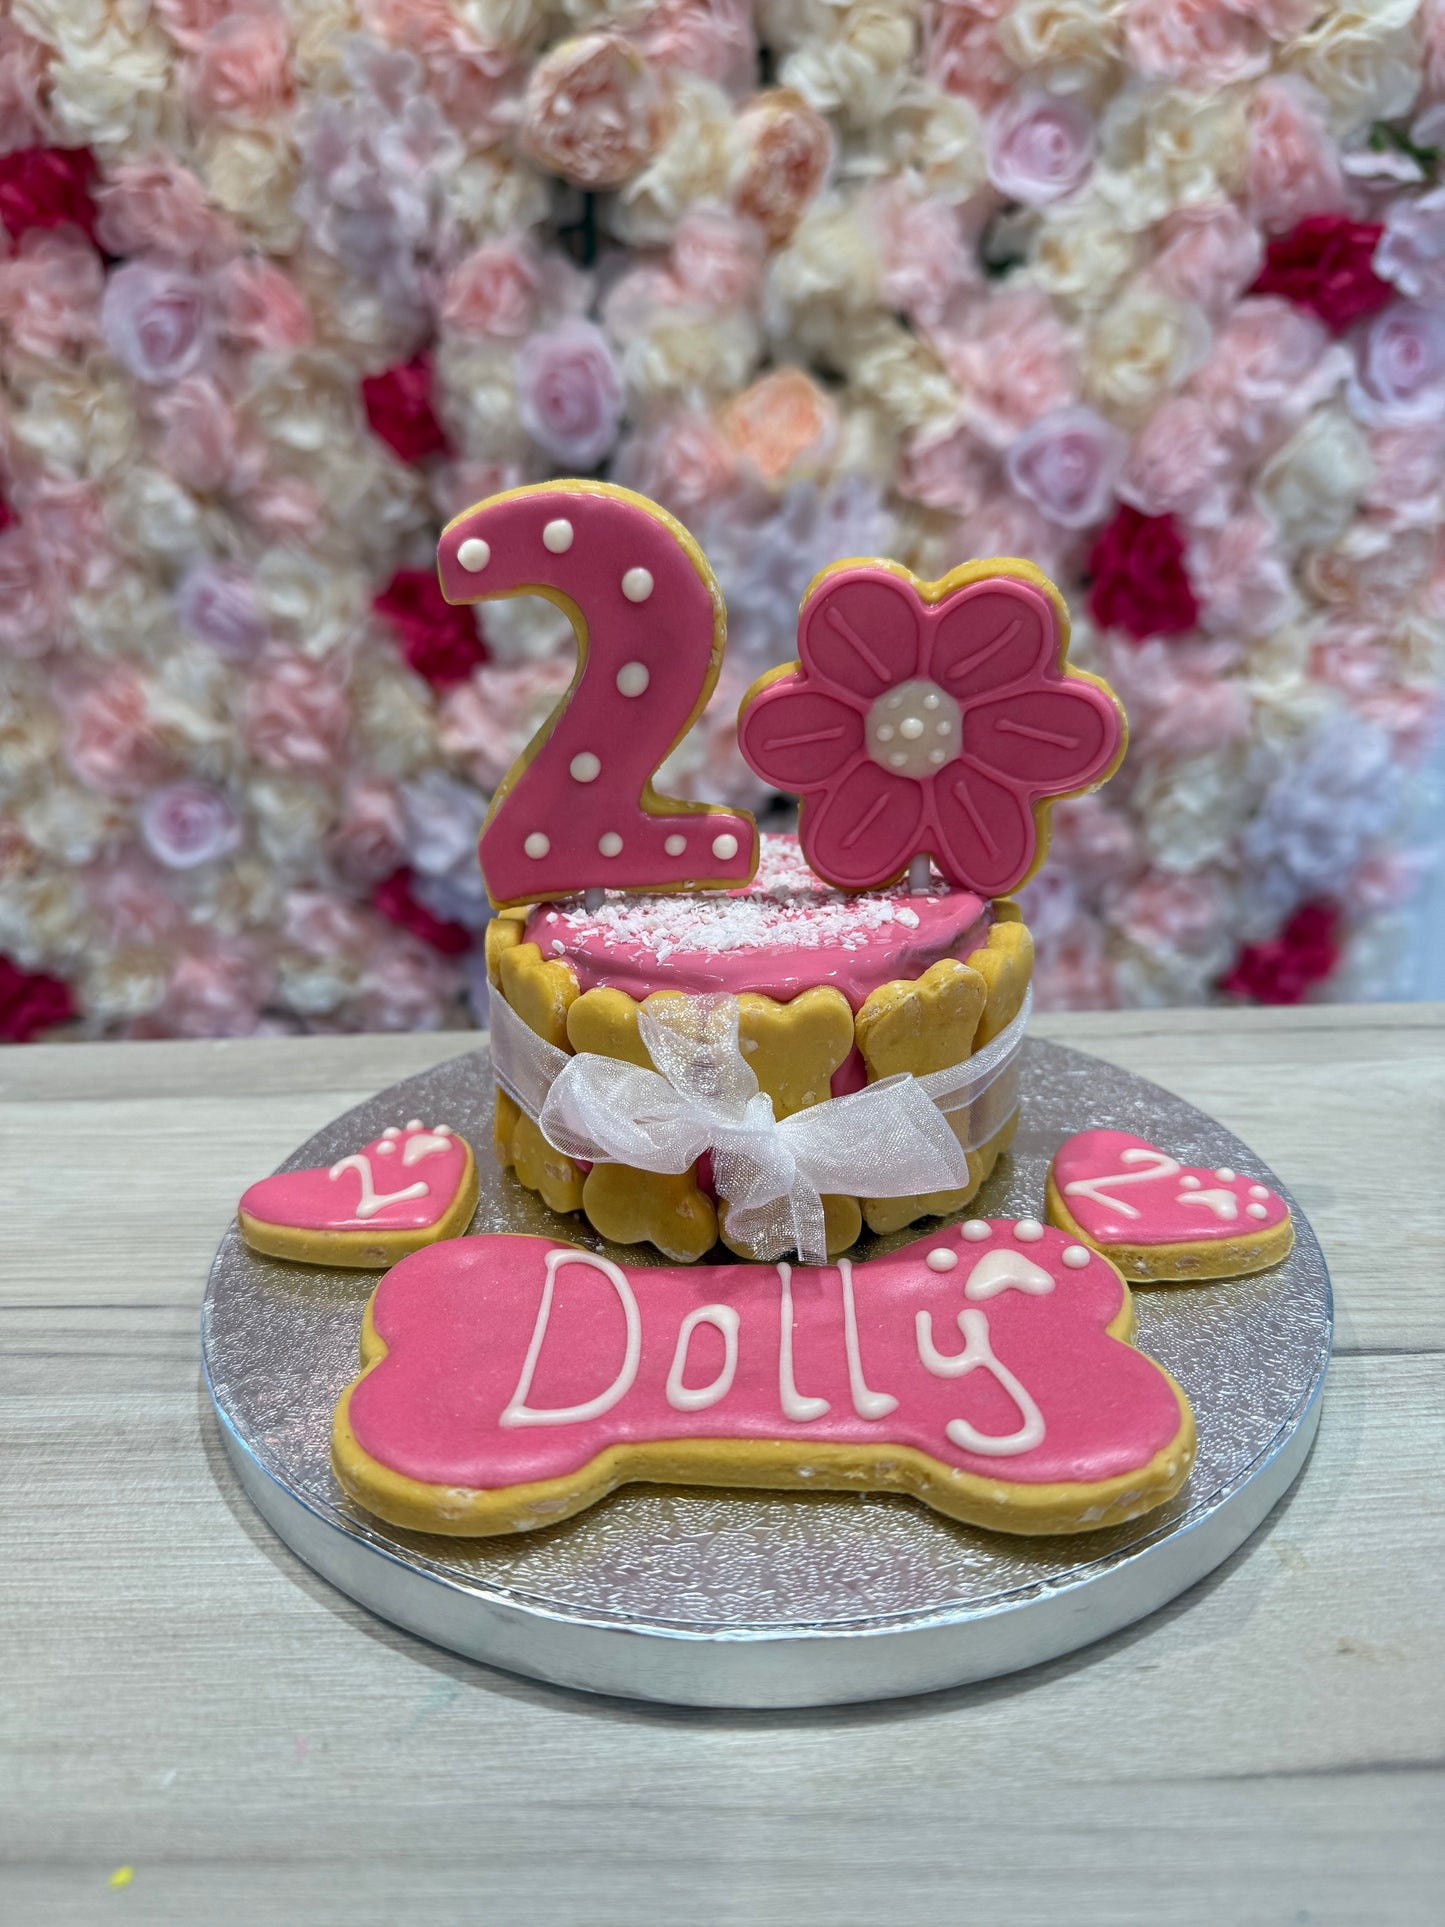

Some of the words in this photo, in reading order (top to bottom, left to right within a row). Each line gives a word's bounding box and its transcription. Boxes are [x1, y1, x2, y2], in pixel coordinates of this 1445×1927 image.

[437, 479, 760, 909] 2
[329, 1154, 429, 1219] 2
[1064, 1148, 1180, 1219] 2
[500, 1249, 1046, 1457] Dolly
